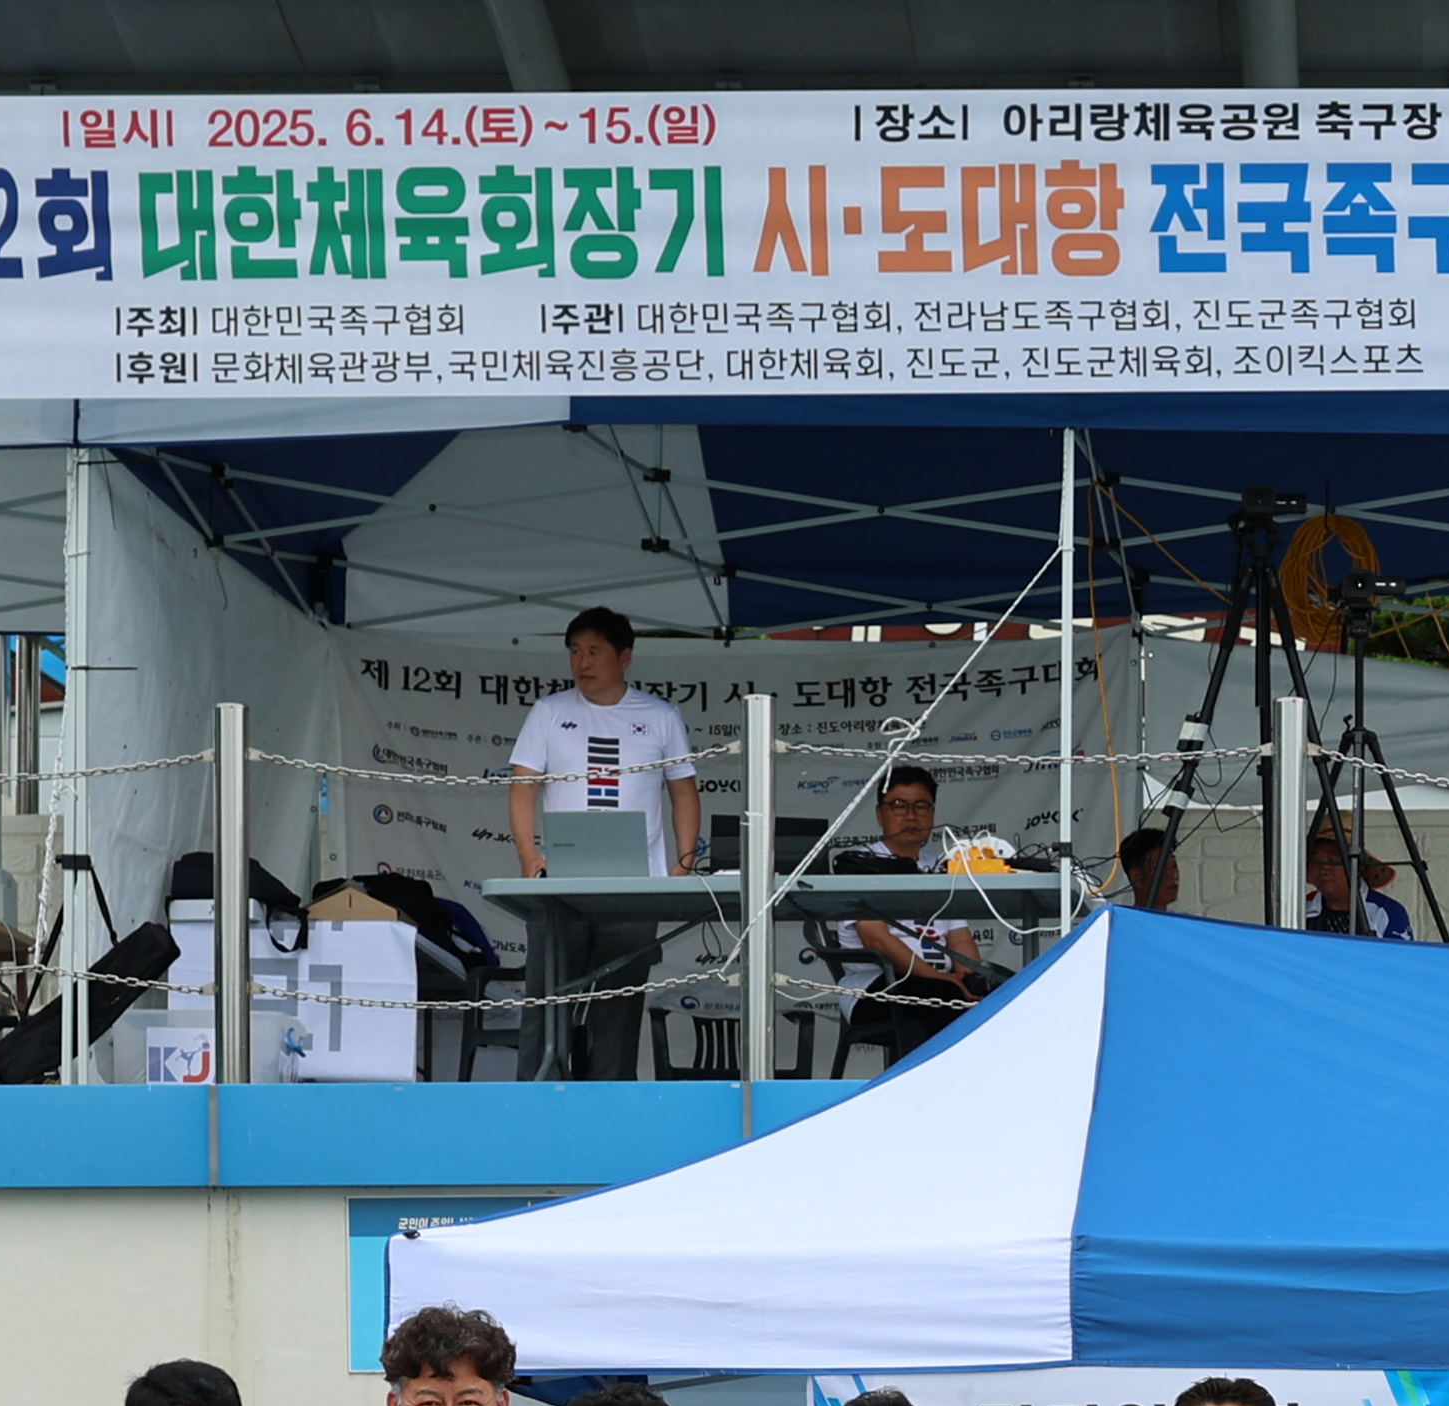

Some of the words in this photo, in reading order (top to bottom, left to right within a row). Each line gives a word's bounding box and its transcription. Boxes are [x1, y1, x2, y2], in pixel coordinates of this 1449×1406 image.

[208, 109, 327, 147] 2025.
[1003, 102, 1301, 141] 아리랑체육공원
[1315, 101, 1442, 141] 축구장
[139, 165, 725, 281] 대한체육회장기
[210, 305, 465, 336] 대한민국족구협회
[638, 300, 902, 334] 대한민국족구협회,
[914, 299, 1182, 332] 전라남도족구협회,
[1192, 298, 1417, 331] 진도군족구협회
[727, 348, 895, 382] 대한체육회,
[906, 346, 1011, 380] 진도군,
[1021, 344, 1223, 378] 진도군체육회,
[1233, 343, 1424, 376] 조이킥스포츠
[793, 674, 892, 709] 도대항
